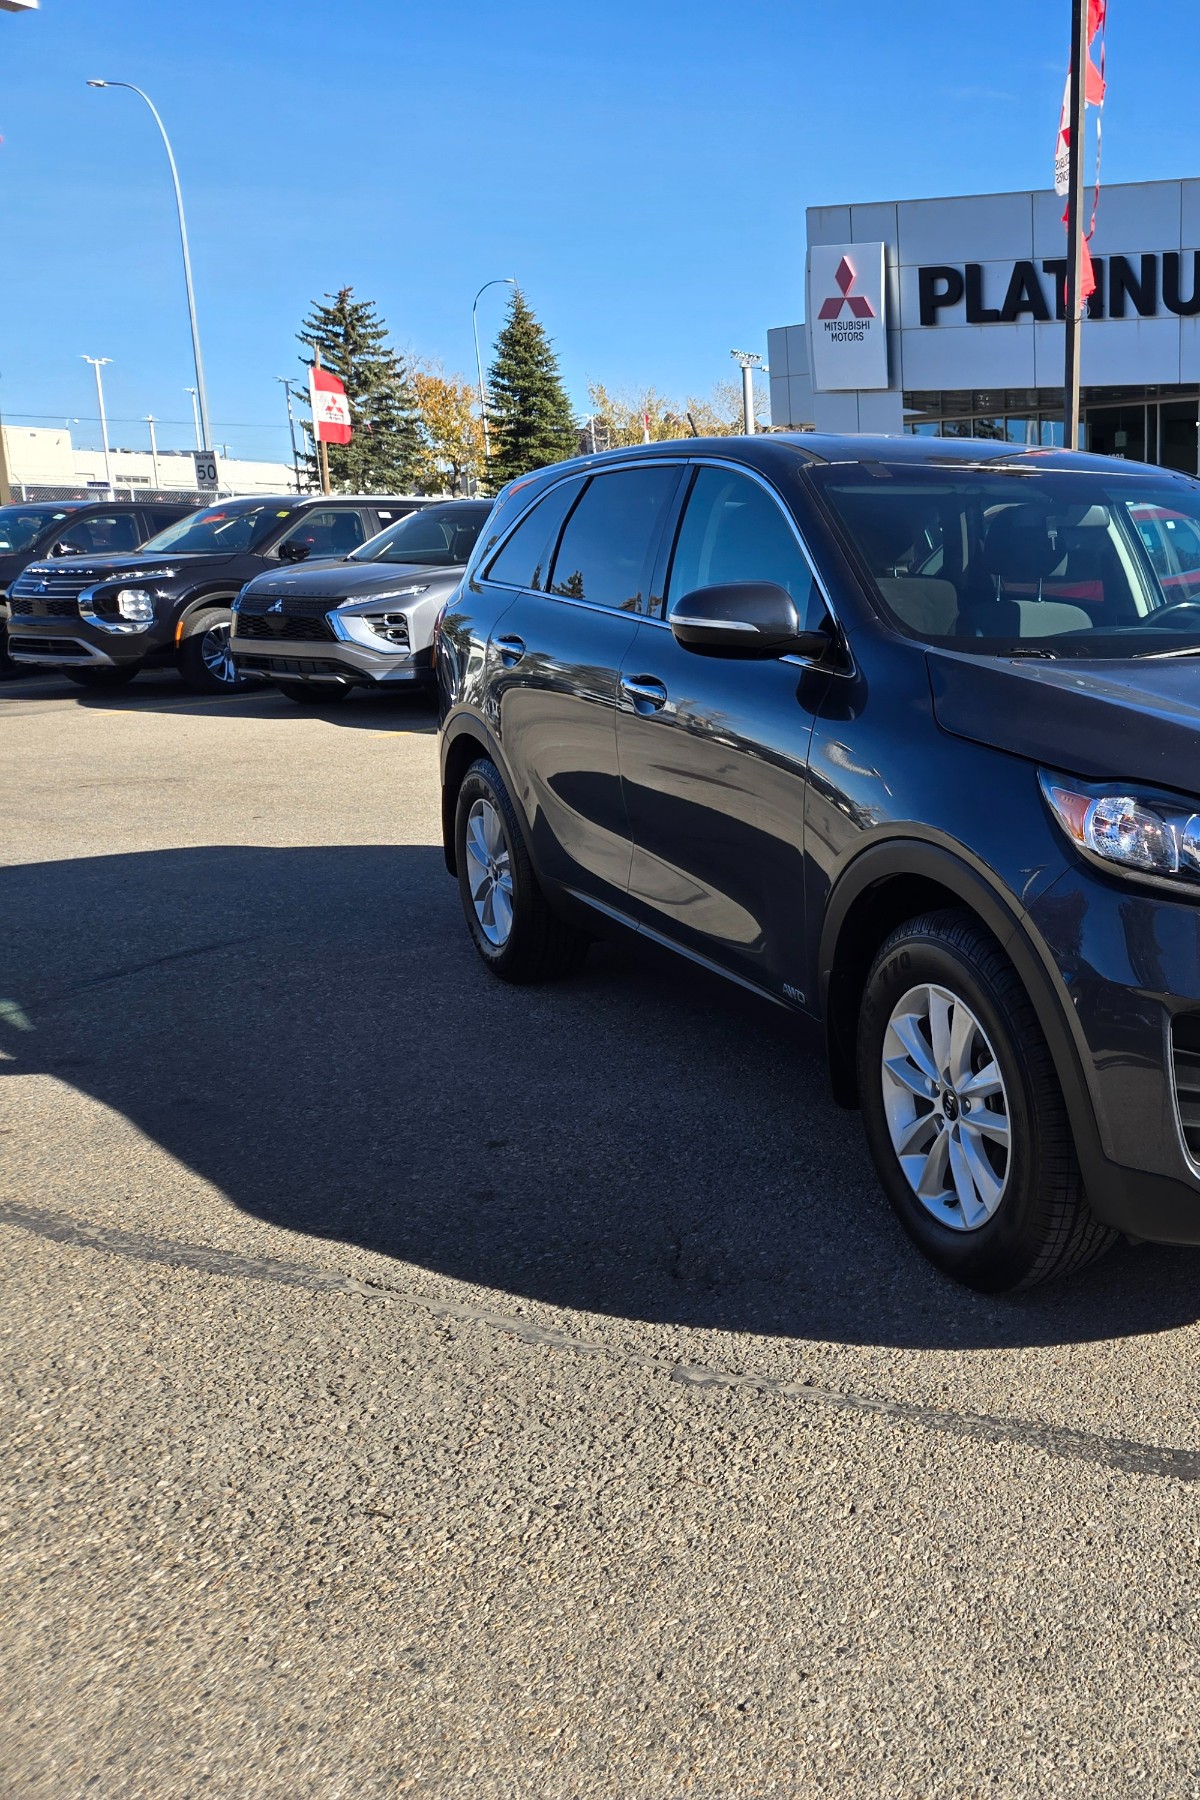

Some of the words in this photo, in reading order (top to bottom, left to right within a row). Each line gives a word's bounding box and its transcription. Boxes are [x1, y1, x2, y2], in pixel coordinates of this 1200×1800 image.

[824, 320, 871, 331] MITSUBISHI
[831, 331, 864, 342] MOTORS
[197, 464, 217, 480] 50
[945, 1095, 955, 1118] KIA
